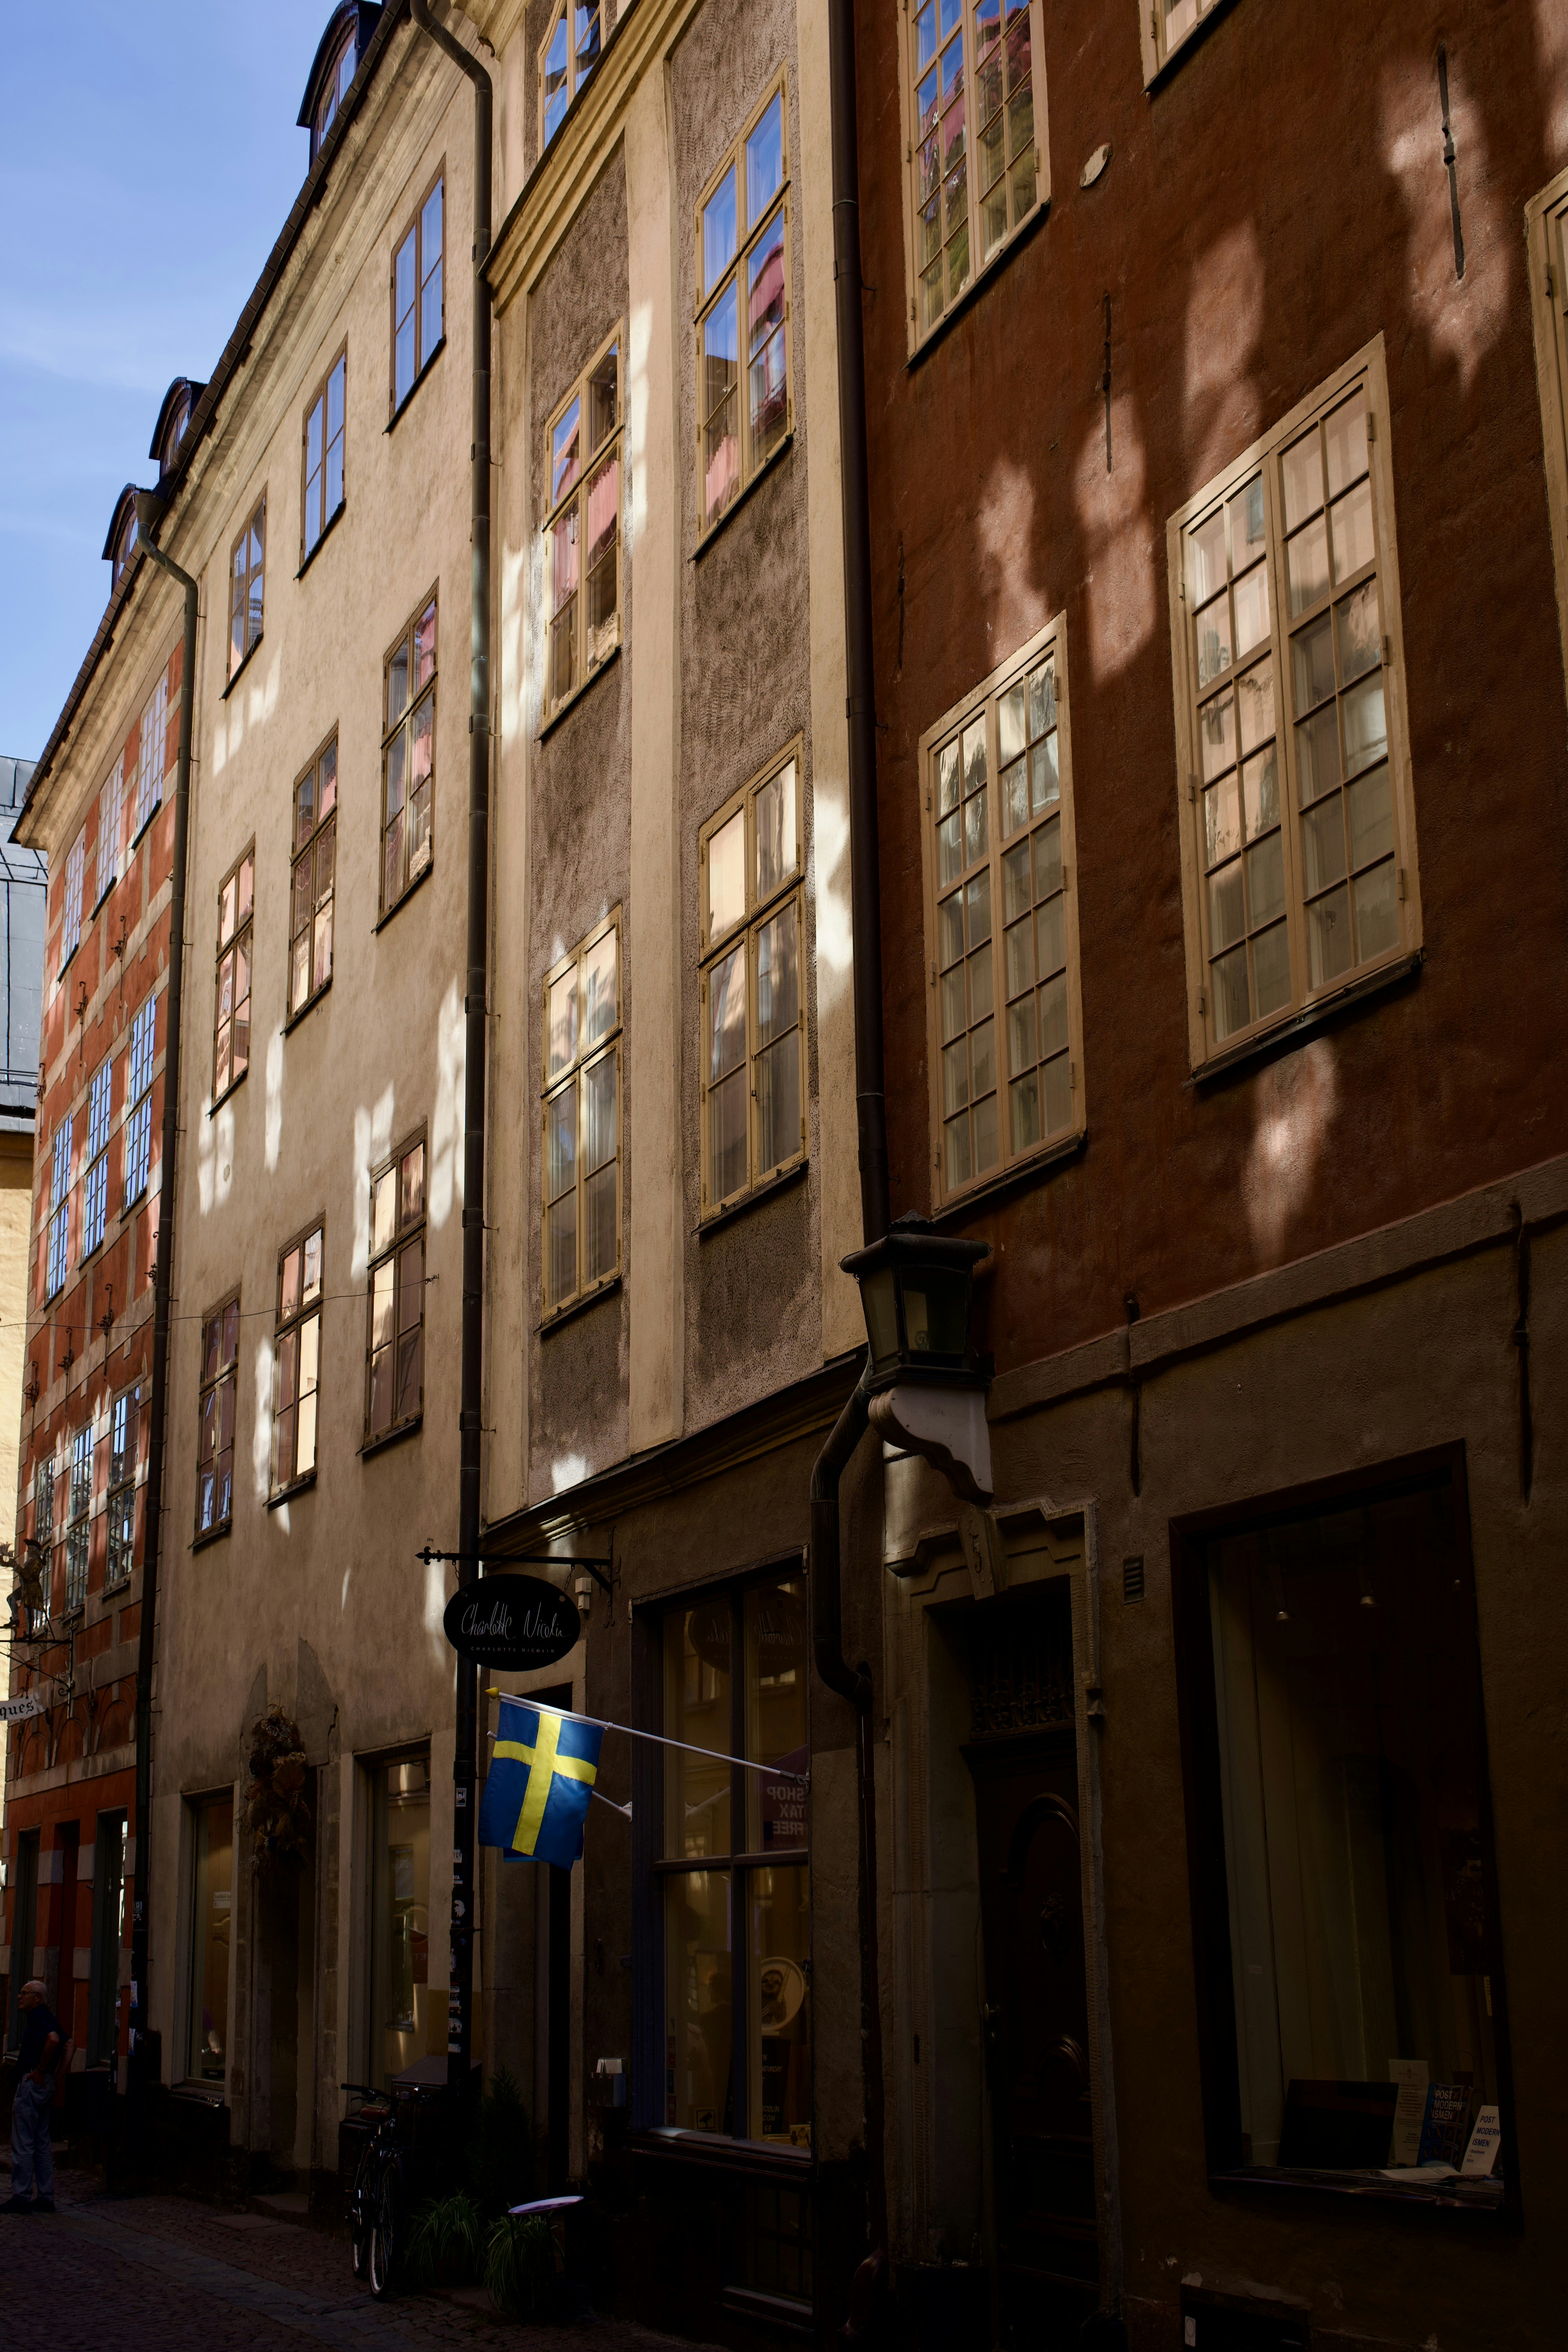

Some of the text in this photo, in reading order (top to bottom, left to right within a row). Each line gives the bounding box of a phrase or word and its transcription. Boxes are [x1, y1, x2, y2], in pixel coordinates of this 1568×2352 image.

[462, 1601, 571, 1640] Charlotte Nicolin
[1435, 2090, 1453, 2100] POST
[1434, 2100, 1462, 2111] MODERN
[1432, 2109, 1453, 2120] ISMEN
[1480, 2115, 1496, 2123] POST
[1476, 2127, 1500, 2136] MODERN
[1472, 2138, 1490, 2147] ISMEN
